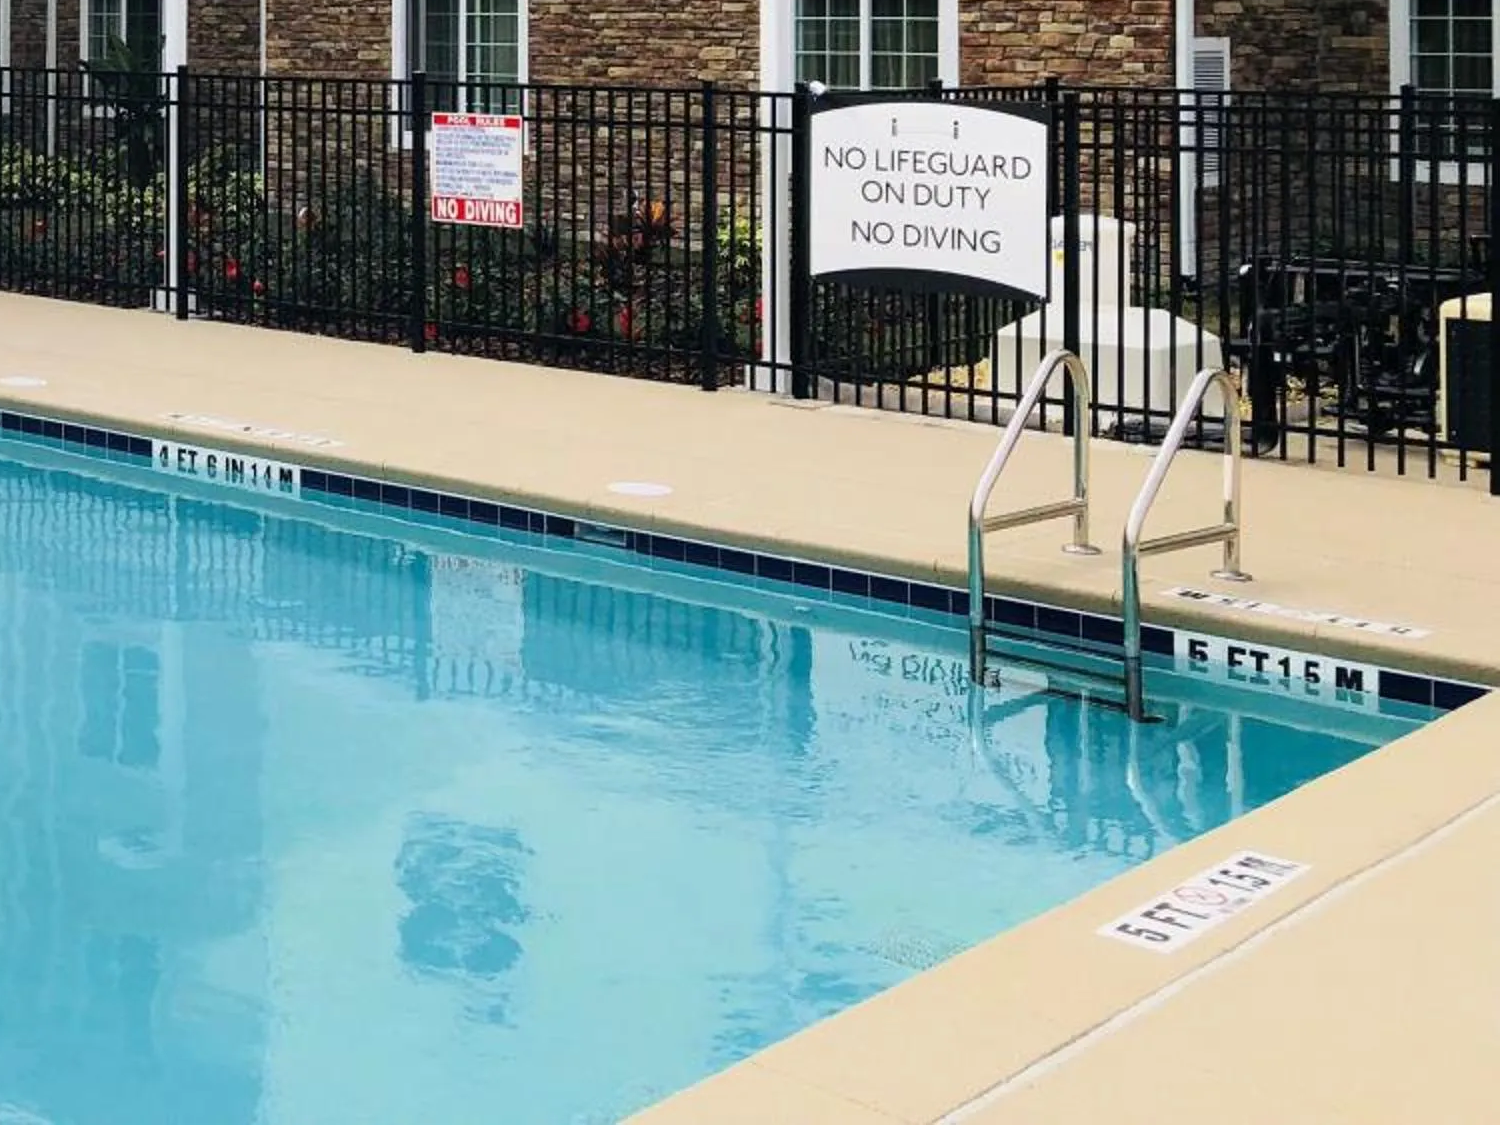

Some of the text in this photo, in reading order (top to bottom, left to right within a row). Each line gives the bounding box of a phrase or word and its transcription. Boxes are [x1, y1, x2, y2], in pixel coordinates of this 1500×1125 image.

[824, 146, 1032, 180] NO LIFEGUARD
[861, 180, 991, 210] ON DUTY
[436, 198, 517, 224] NO DIVING
[851, 220, 1001, 254] NO DIVING
[1188, 638, 1209, 662] 5
[1140, 902, 1210, 929] FT
[1116, 923, 1171, 942] 5
